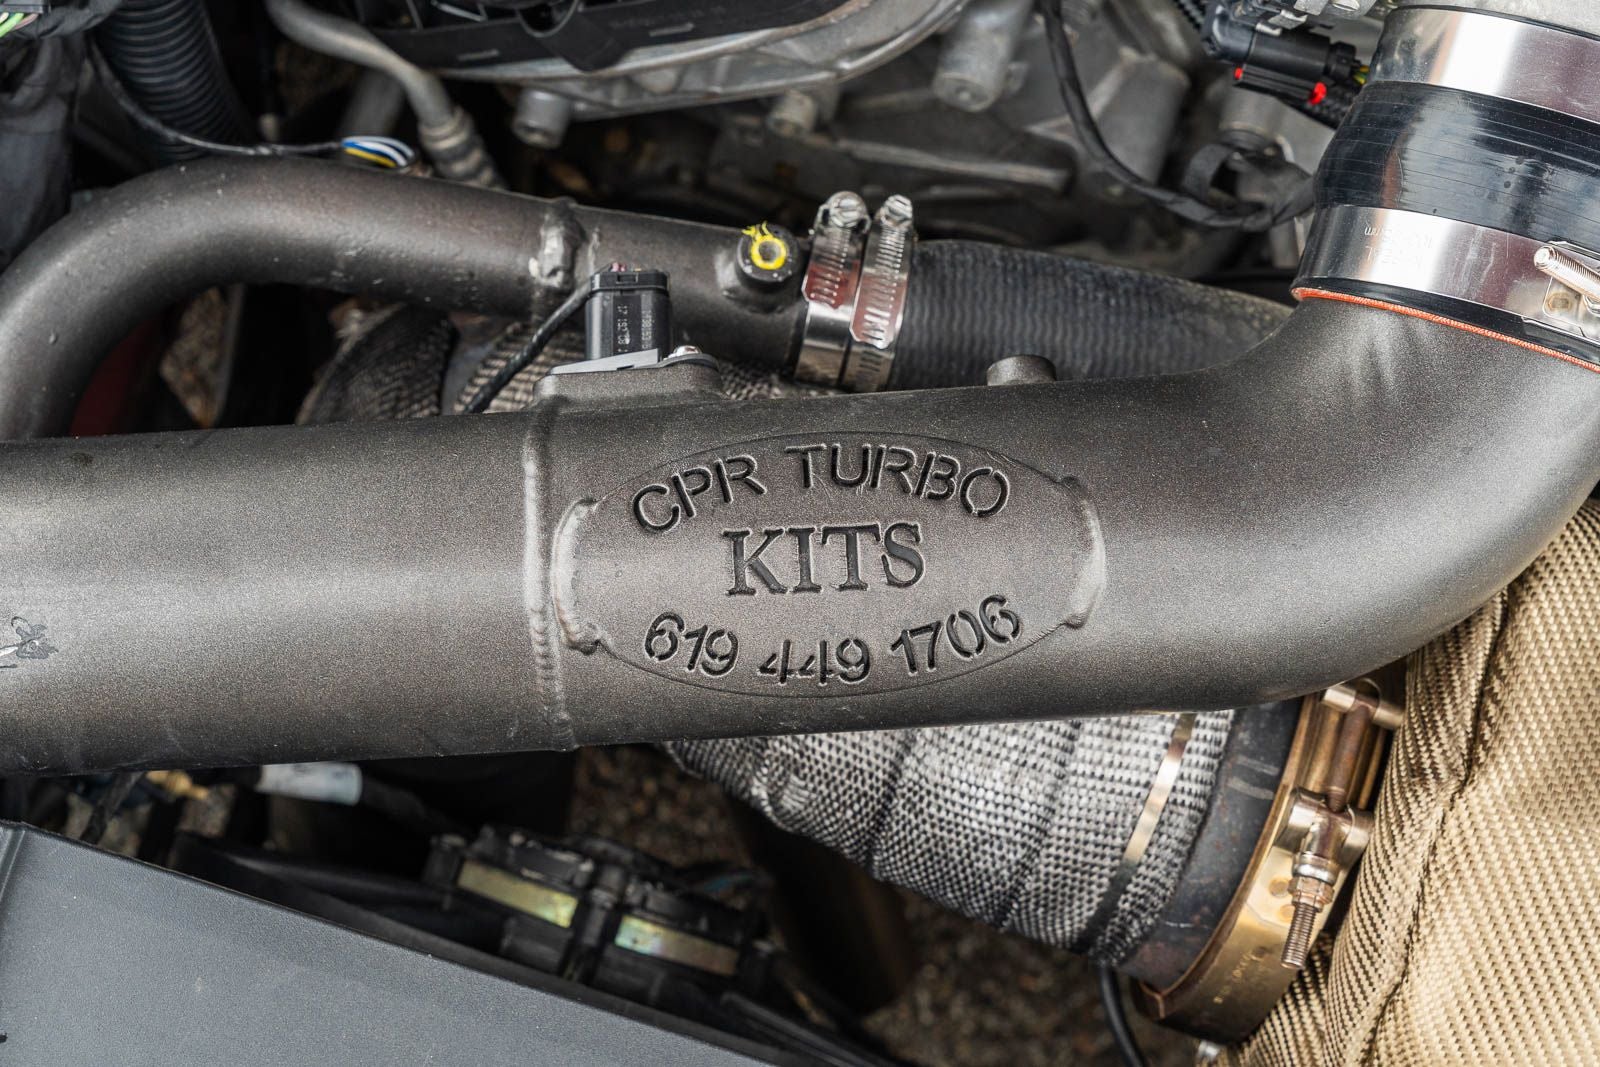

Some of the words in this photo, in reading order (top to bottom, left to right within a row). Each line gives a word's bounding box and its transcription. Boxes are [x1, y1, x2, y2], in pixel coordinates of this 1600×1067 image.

[632, 454, 768, 533] CPR
[785, 443, 1011, 518] TURBO
[722, 522, 925, 596] KITS
[644, 611, 738, 678] 619
[756, 638, 870, 686] 449
[889, 594, 1021, 676] 1706
